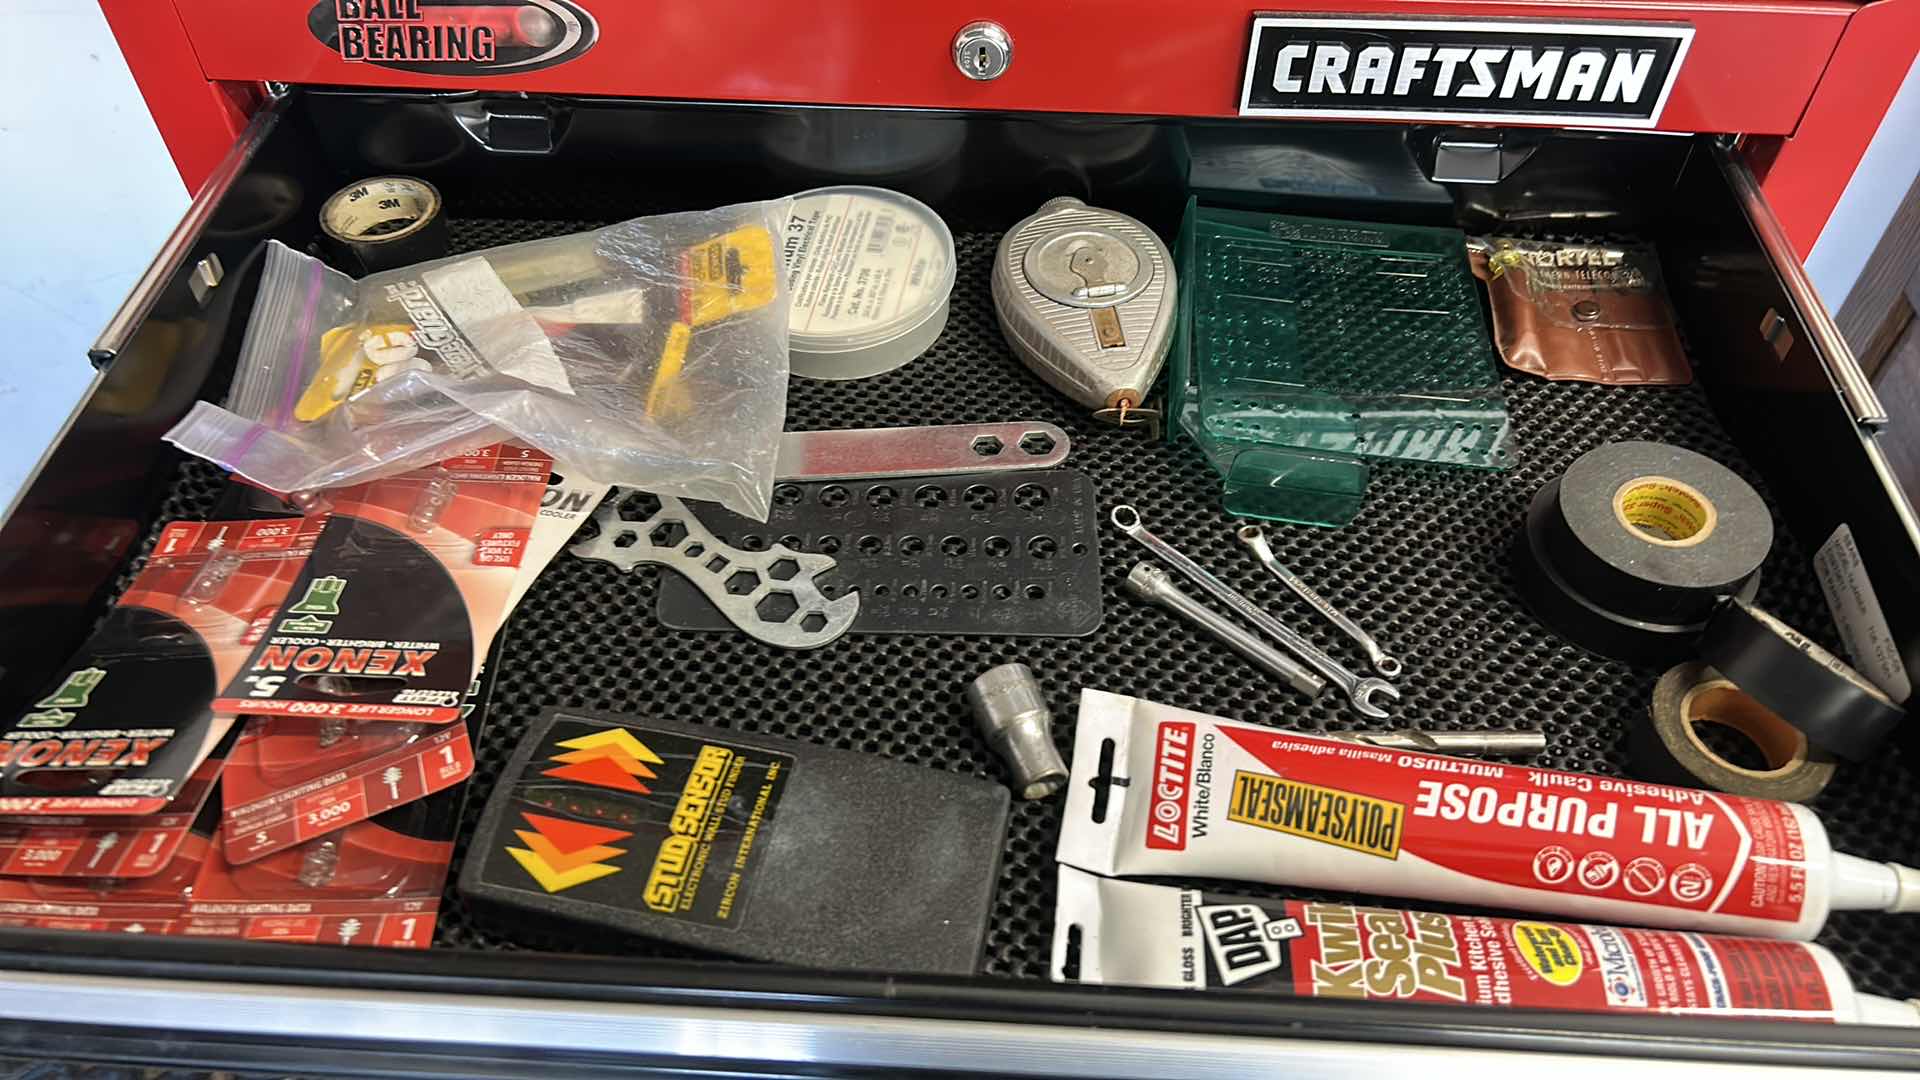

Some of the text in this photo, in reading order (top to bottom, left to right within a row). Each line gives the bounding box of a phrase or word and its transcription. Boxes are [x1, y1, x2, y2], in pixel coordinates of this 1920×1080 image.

[337, 0, 422, 20] BALL
[341, 25, 496, 61] BEARING
[1272, 41, 1656, 103] CRAFTSMAN
[349, 186, 370, 202] 3M
[378, 198, 401, 210] 3M
[788, 215, 807, 232] 37
[521, 450, 531, 458] 5
[163, 538, 178, 553] 1
[269, 636, 440, 650] WHITER BRIGHTER COOLER
[251, 644, 437, 676] XENON
[238, 700, 288, 711] HOURS
[351, 703, 378, 714] LIFE
[379, 705, 434, 717] LONGER
[439, 745, 455, 765] 1
[1271, 740, 1504, 779] MULTIUSO Masilla adhesiva
[323, 772, 348, 788] DATA
[1152, 727, 1189, 844] LOCTITE
[1192, 733, 1216, 838] White/Blanco
[1528, 770, 1705, 806] Adhesive Caulk
[1239, 775, 1399, 853] POLYSEAMSEAL
[1413, 780, 1619, 839] PURPOSE
[148, 832, 168, 854] 1
[643, 744, 734, 913] STUD SENSOR
[680, 755, 747, 910] ELECTRONIC WALL STUD FINDER
[1633, 805, 1715, 850] ALL
[716, 871, 741, 919] ZIRCON
[734, 783, 772, 869] INTERNATIONAL
[401, 917, 418, 943] 1
[1463, 922, 1487, 971] Kitchen
[1182, 947, 1195, 982] GLOSS
